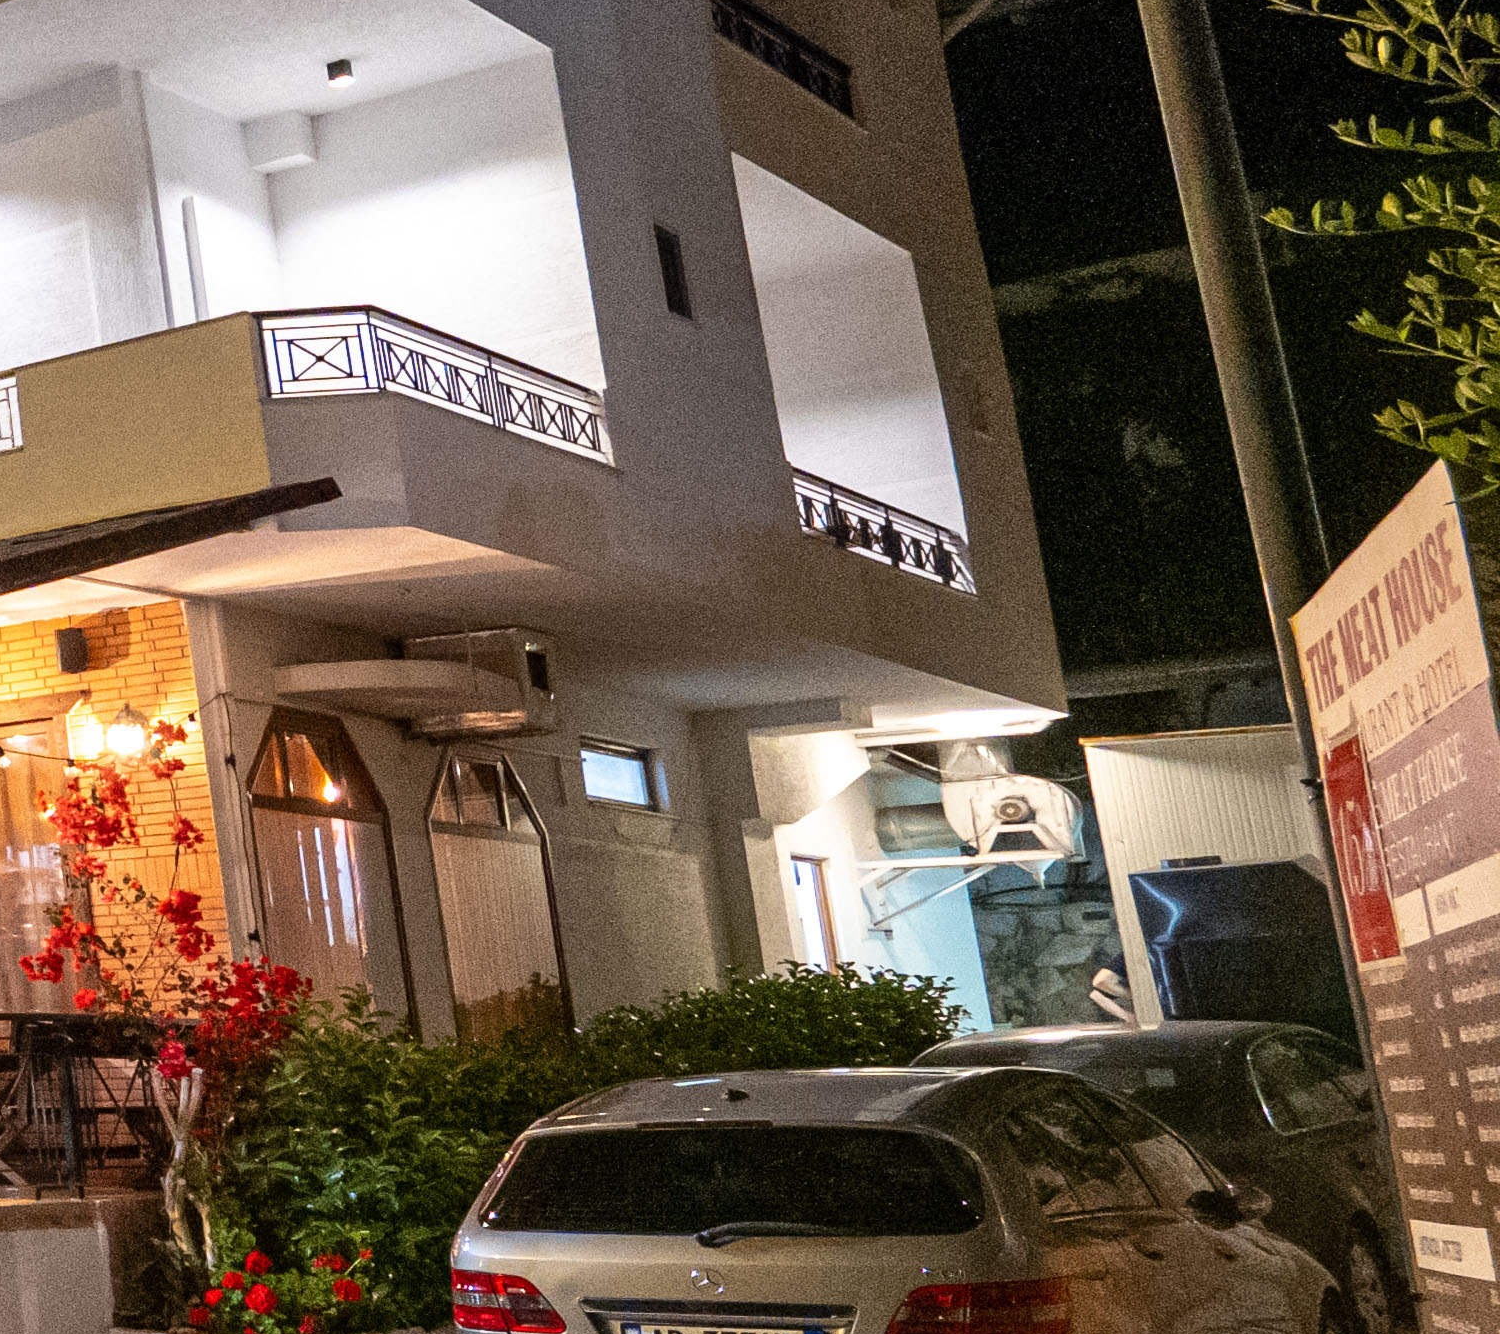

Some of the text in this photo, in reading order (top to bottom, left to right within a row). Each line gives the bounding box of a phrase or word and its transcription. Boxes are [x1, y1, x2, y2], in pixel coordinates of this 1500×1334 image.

[1305, 520, 1463, 713] THE MEAT HOUSE
[1403, 683, 1419, 726] &
[1416, 647, 1468, 718] HOTEL
[1378, 731, 1468, 825] MEAT HOUSE
